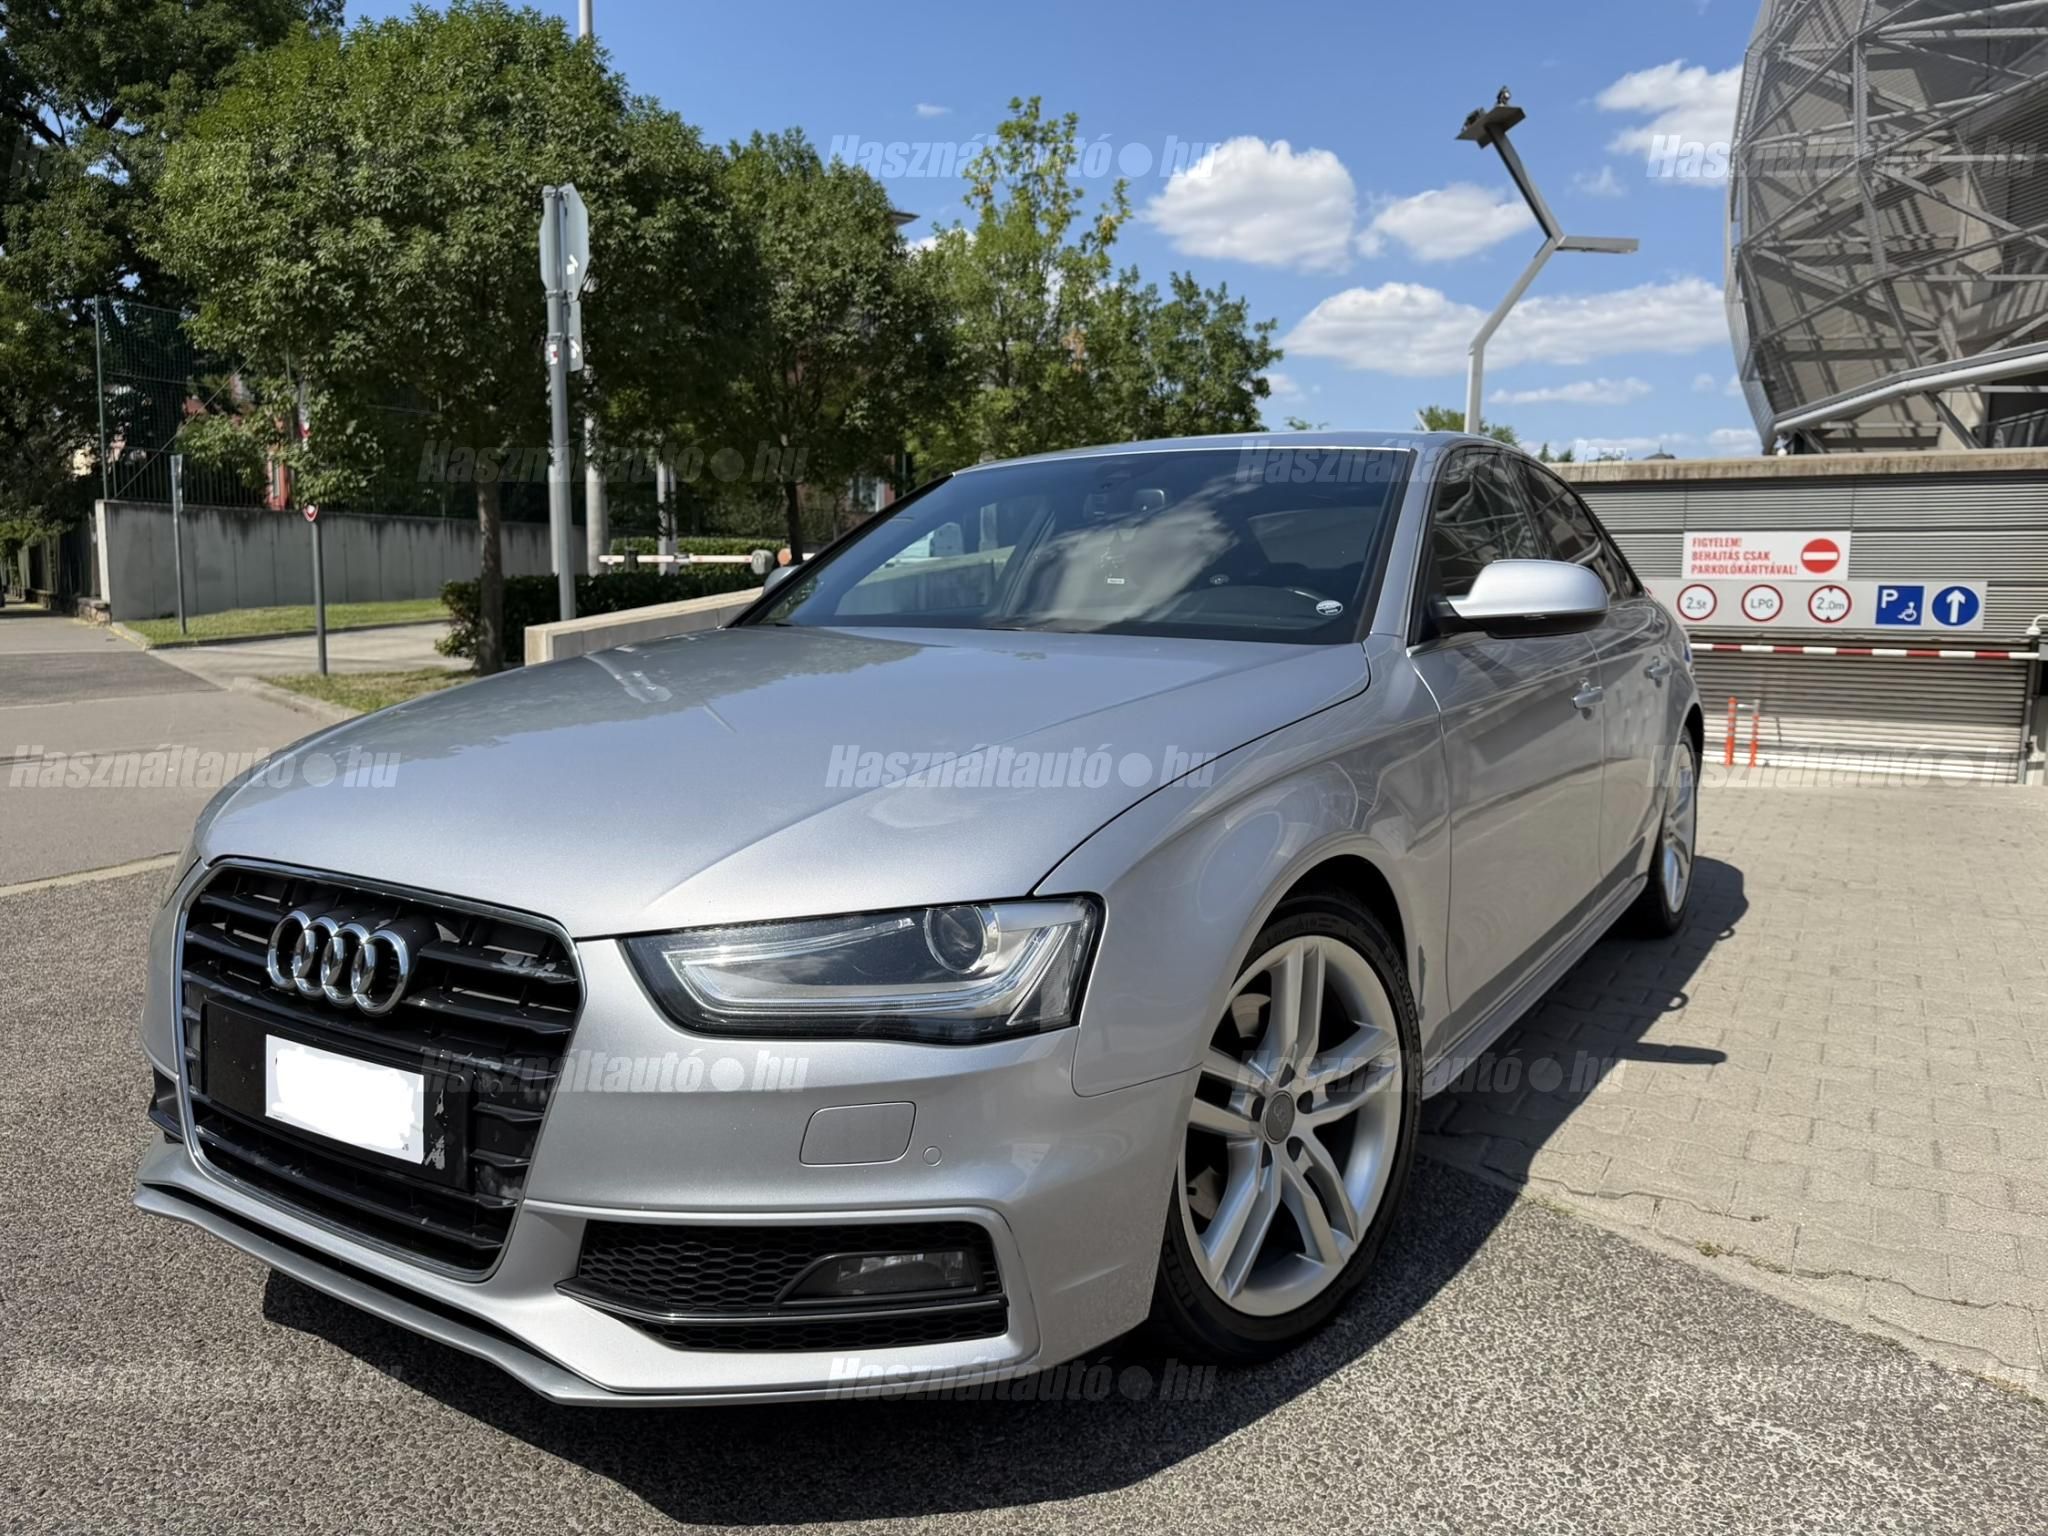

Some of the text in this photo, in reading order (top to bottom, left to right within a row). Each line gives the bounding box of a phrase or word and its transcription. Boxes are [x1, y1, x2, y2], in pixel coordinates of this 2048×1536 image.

[1692, 537, 1742, 548] FIGYELEM!
[1691, 550, 1771, 561] BEHAJTÁS CSAK
[1690, 562, 1798, 575] PARKOLÓKÁRTYÁVAL!
[1750, 598, 1774, 609] LPG
[1881, 589, 1898, 608] P
